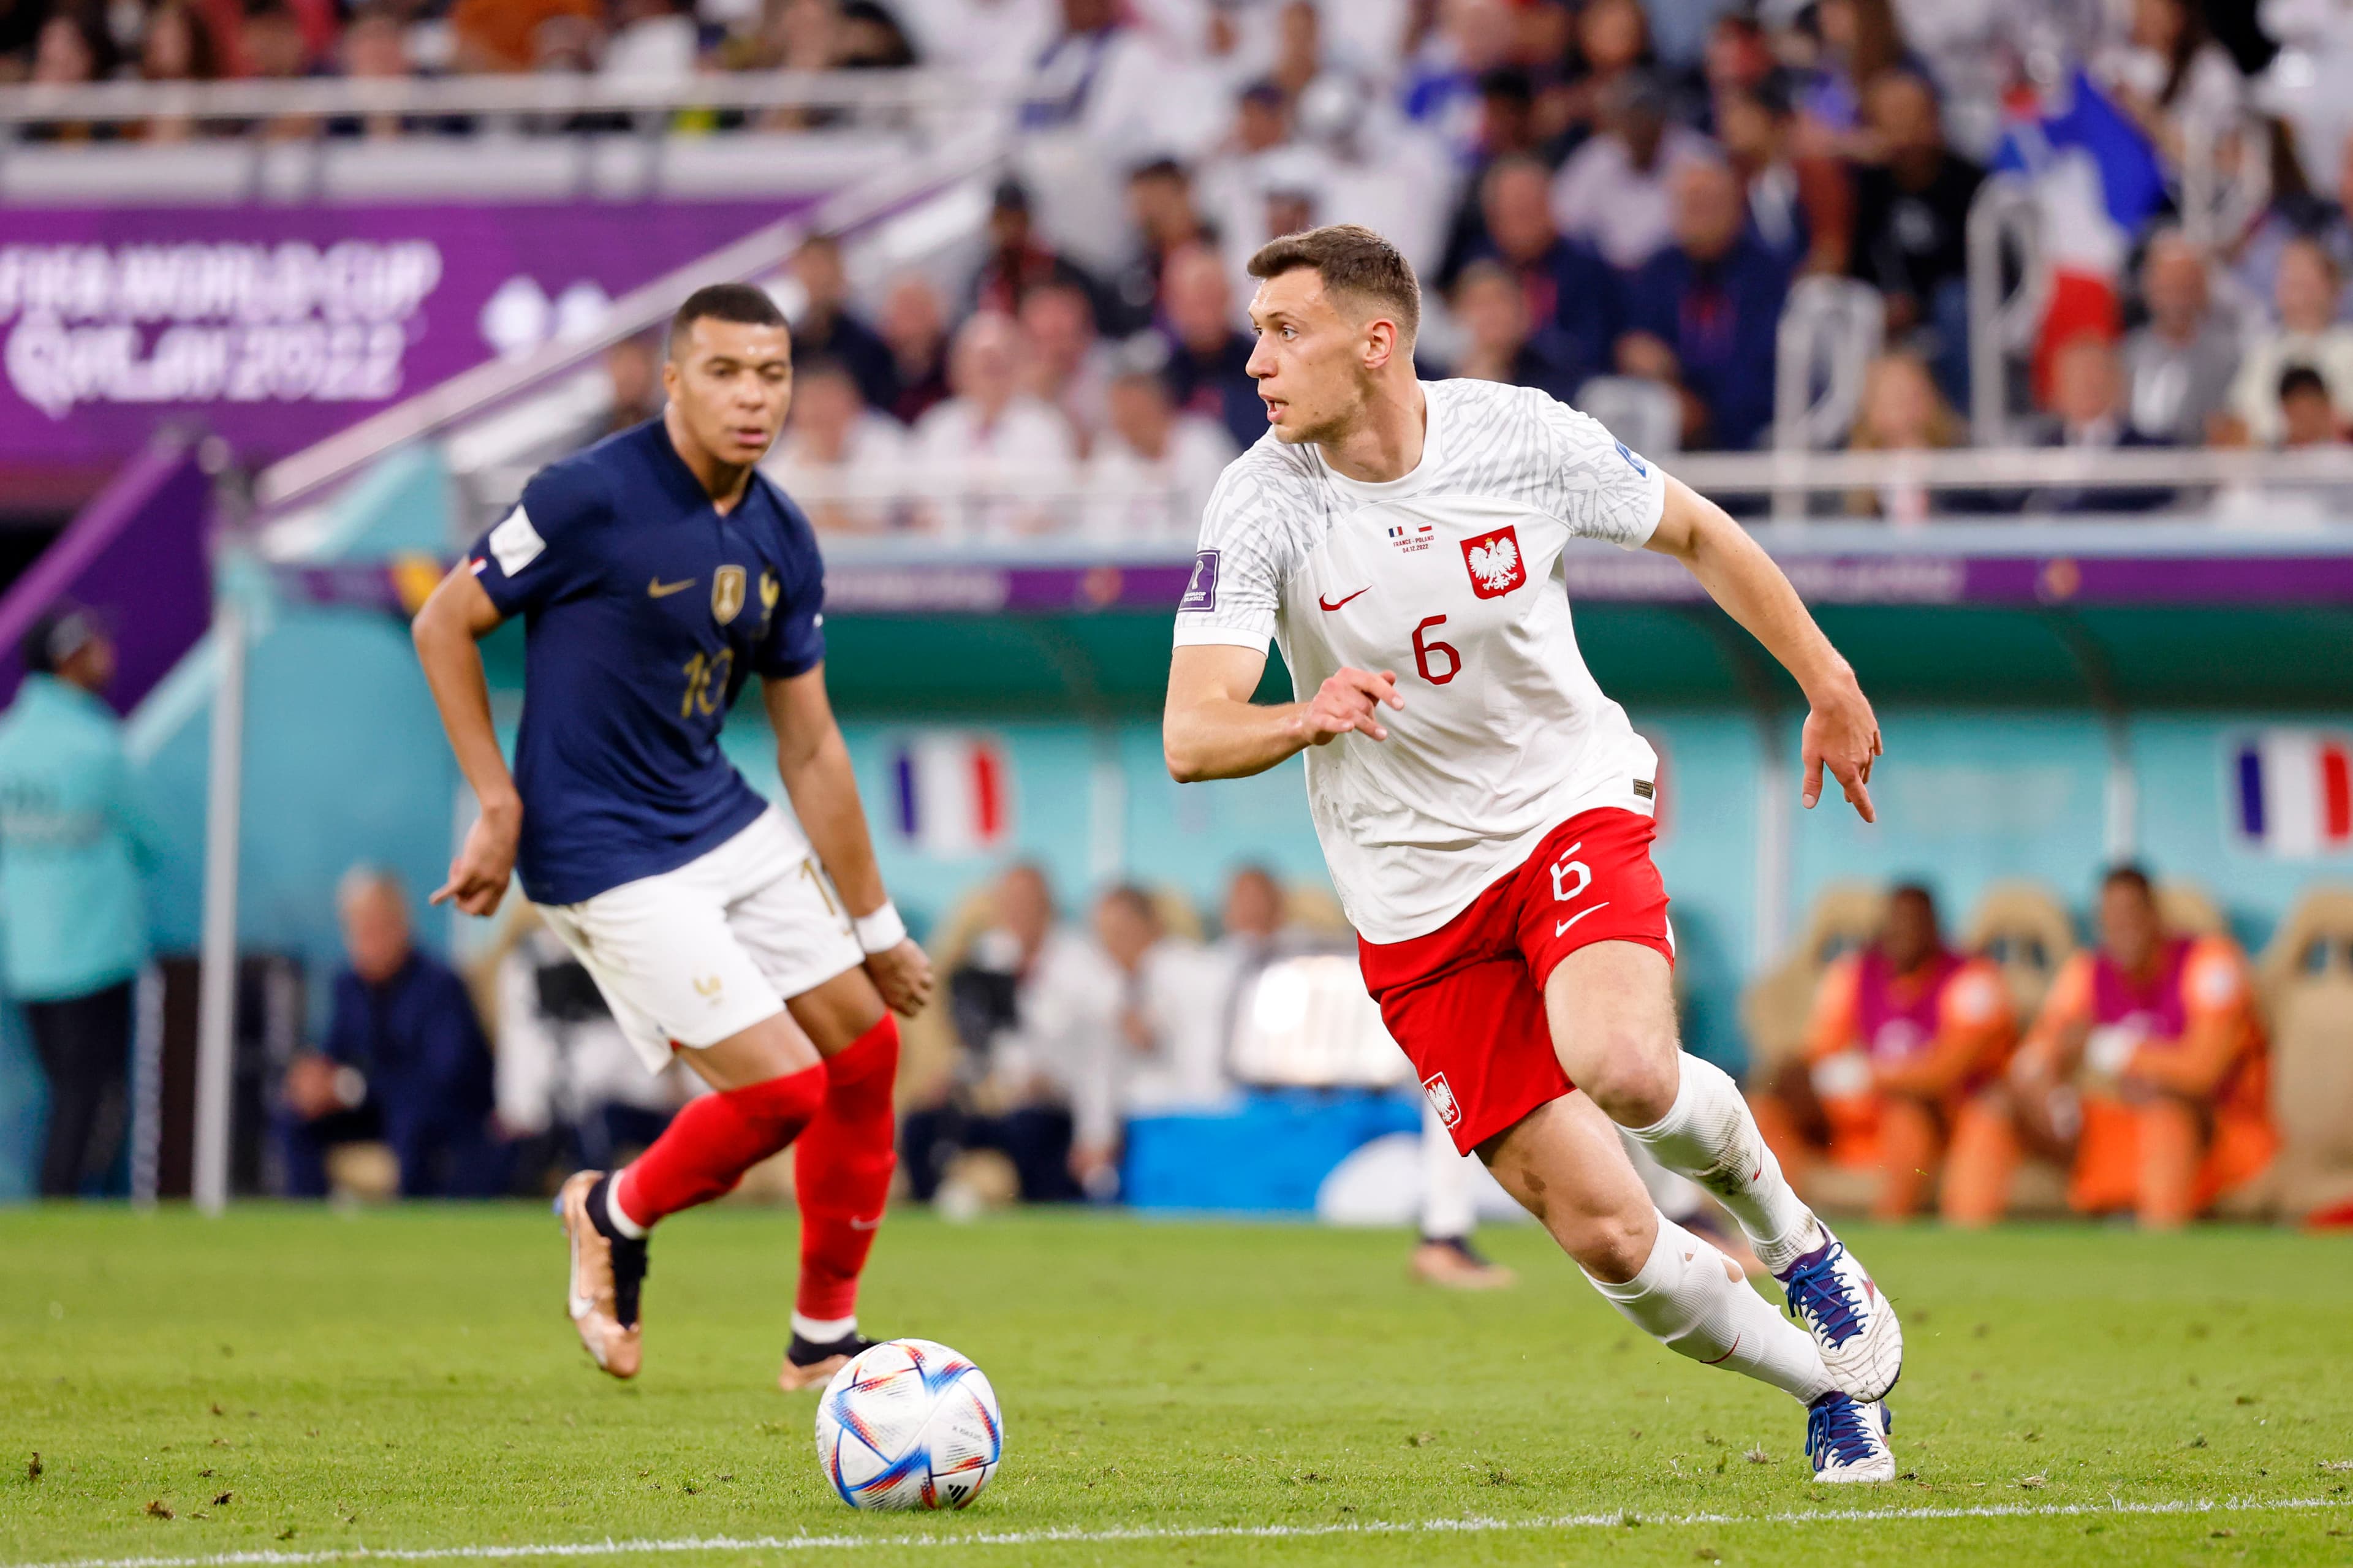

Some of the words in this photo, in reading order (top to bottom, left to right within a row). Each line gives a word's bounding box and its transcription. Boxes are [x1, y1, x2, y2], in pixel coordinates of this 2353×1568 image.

[1393, 539, 1412, 547] FRANCE
[1415, 535, 1434, 543] POLAND
[1402, 544, 1429, 553] 04.12.2022
[1412, 614, 1461, 685] 6
[681, 647, 734, 718] 10
[1550, 841, 1591, 901] 6
